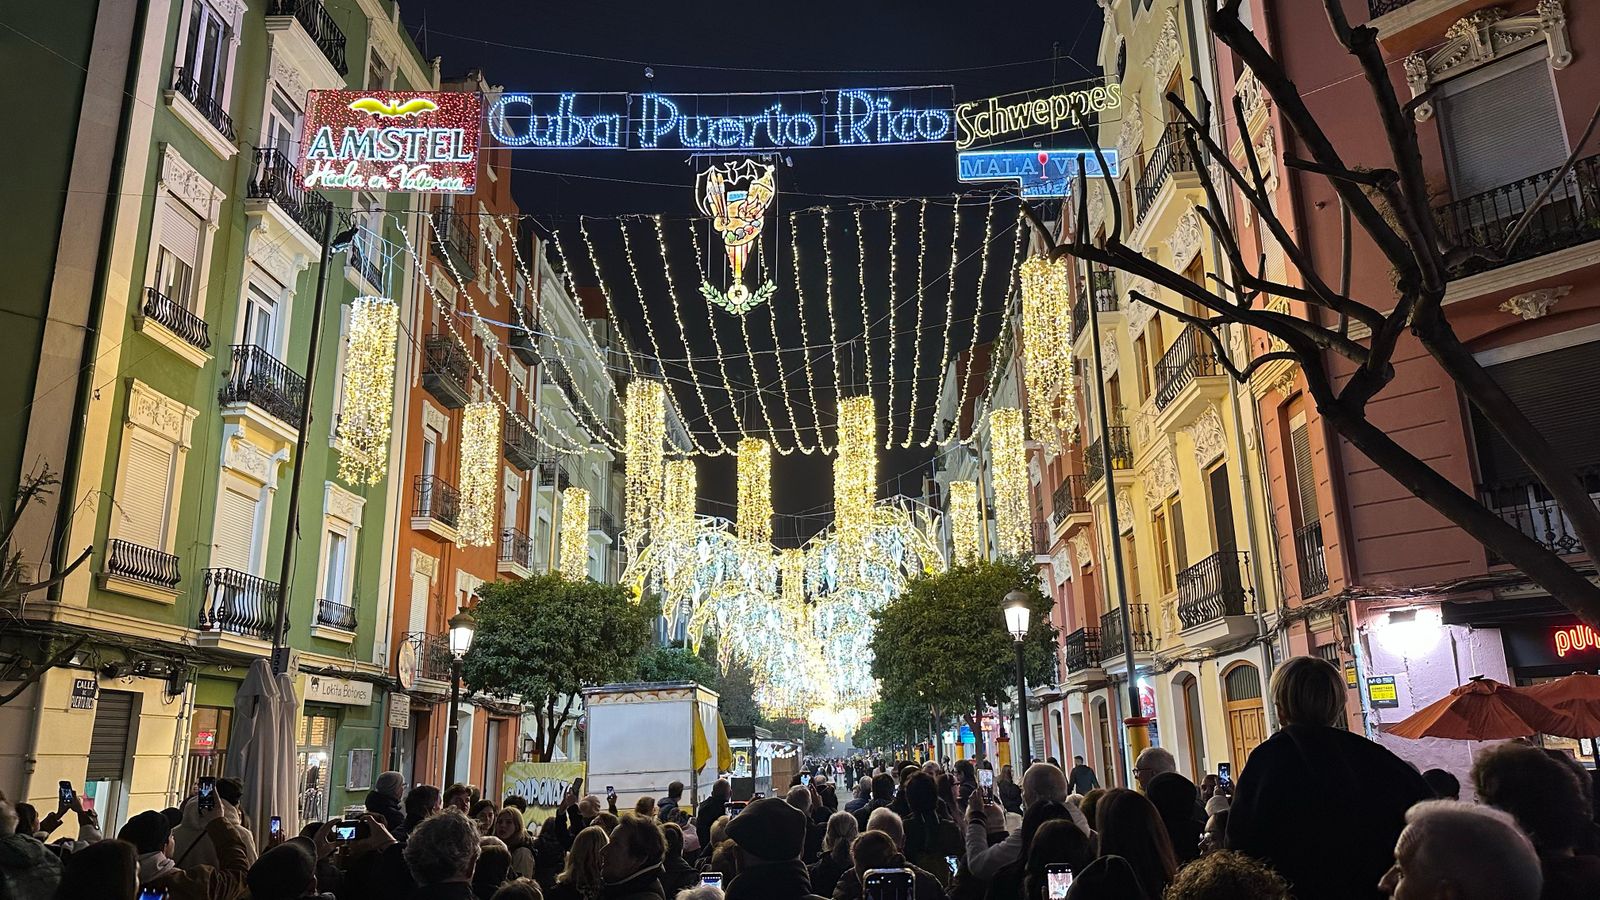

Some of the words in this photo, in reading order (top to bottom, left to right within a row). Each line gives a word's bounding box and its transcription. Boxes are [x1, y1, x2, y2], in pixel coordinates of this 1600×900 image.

[488, 93, 619, 146] Cuba
[637, 93, 817, 147] Puerto
[834, 89, 950, 144] Rico
[955, 83, 1122, 149] Schweppes
[306, 126, 473, 162] AMSTEL
[304, 160, 361, 188] Hecha
[368, 175, 393, 189] en
[389, 163, 466, 190] Valencia
[962, 157, 1039, 177] MALA
[1051, 157, 1116, 176] VID
[76, 680, 95, 690] CALLE
[322, 682, 342, 697] Lokita
